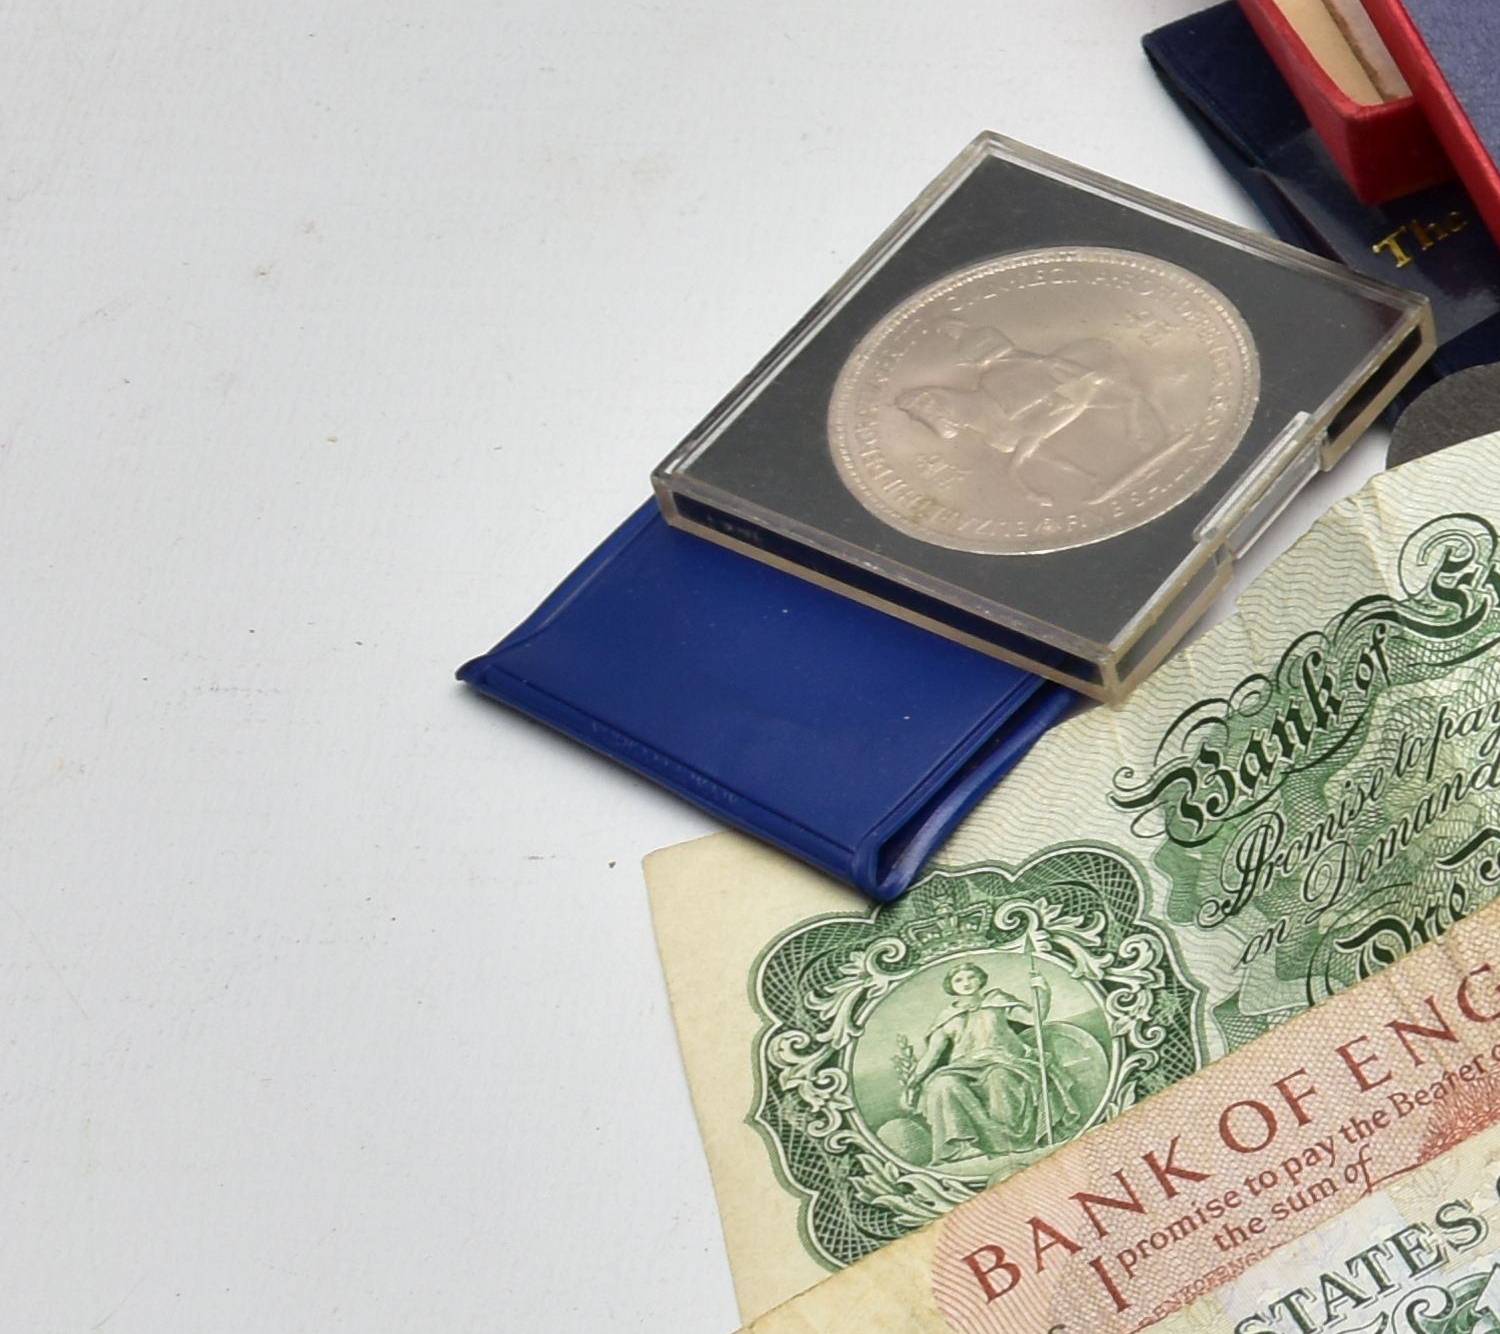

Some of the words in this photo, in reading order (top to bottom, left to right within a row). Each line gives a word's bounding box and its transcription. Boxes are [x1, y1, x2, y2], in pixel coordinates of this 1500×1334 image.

[1372, 211, 1468, 268] The
[1112, 652, 1350, 849] Bank
[1355, 623, 1392, 697] of
[1200, 765, 1385, 929] Promise
[1392, 732, 1432, 785] to
[1233, 917, 1292, 971] on
[961, 1135, 1210, 1304] BANK
[1217, 1070, 1322, 1155] OF
[1088, 1255, 1132, 1315] I
[1116, 1186, 1242, 1277] promise
[1243, 1164, 1278, 1199] to
[1281, 1137, 1338, 1185] pay
[1338, 1108, 1388, 1151] the
[1392, 1049, 1486, 1123] Bearer
[1212, 1216, 1266, 1255] the
[1270, 1177, 1338, 1227] sum
[1340, 1147, 1382, 1215] of
